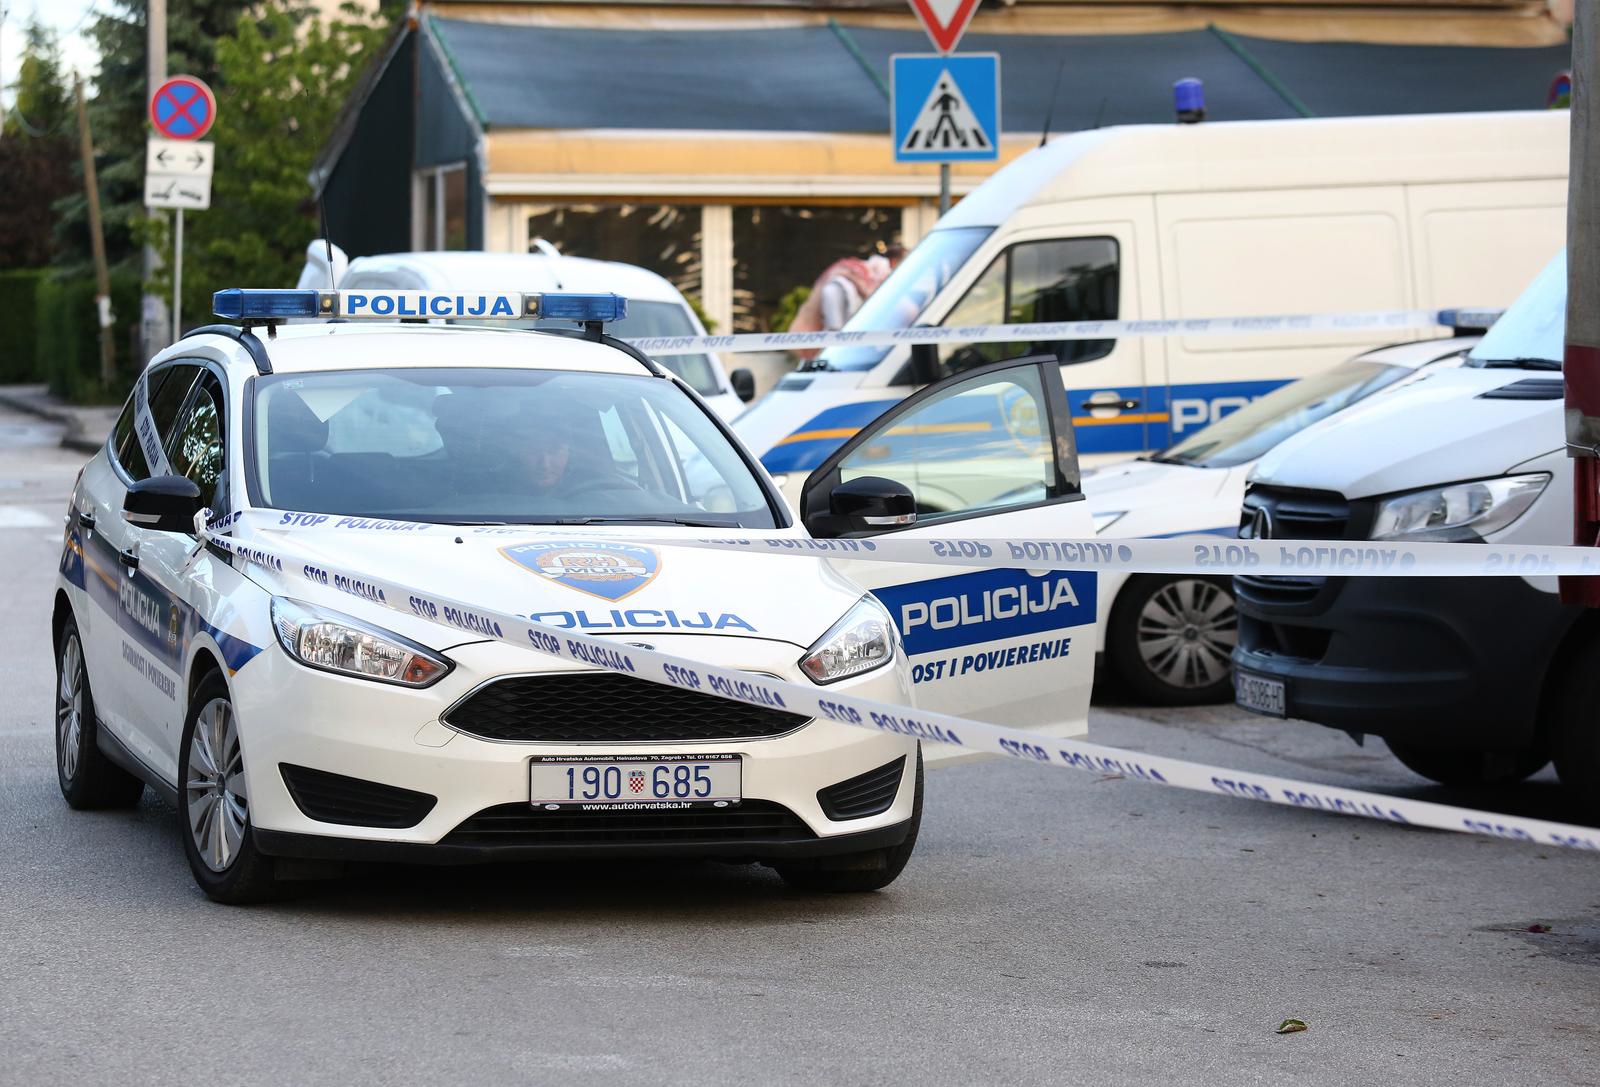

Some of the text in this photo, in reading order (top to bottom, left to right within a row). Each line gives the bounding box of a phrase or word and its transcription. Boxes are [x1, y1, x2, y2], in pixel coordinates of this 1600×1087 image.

[347, 295, 514, 316] POLICIJA
[1171, 396, 1264, 433] PO
[279, 511, 418, 531] STOP POLICIJA
[512, 542, 649, 554] POLICIJA
[303, 564, 379, 602] STOP POLICIJA
[120, 577, 160, 639] POLICIJA
[409, 595, 496, 637] STOP POLICIJA
[515, 609, 759, 632] OLICIJA
[901, 577, 1080, 636] POLICIJA
[527, 628, 627, 672] STOP POLICIJA
[949, 658, 957, 677] I
[960, 638, 1072, 675] POVJERENJE
[663, 662, 775, 707] STOP POLICIJA
[818, 699, 950, 743] STOP POLICIJA
[999, 738, 1050, 761] STOP
[566, 765, 712, 799] 190 685
[582, 801, 692, 811] www.autohrvatska.hr
